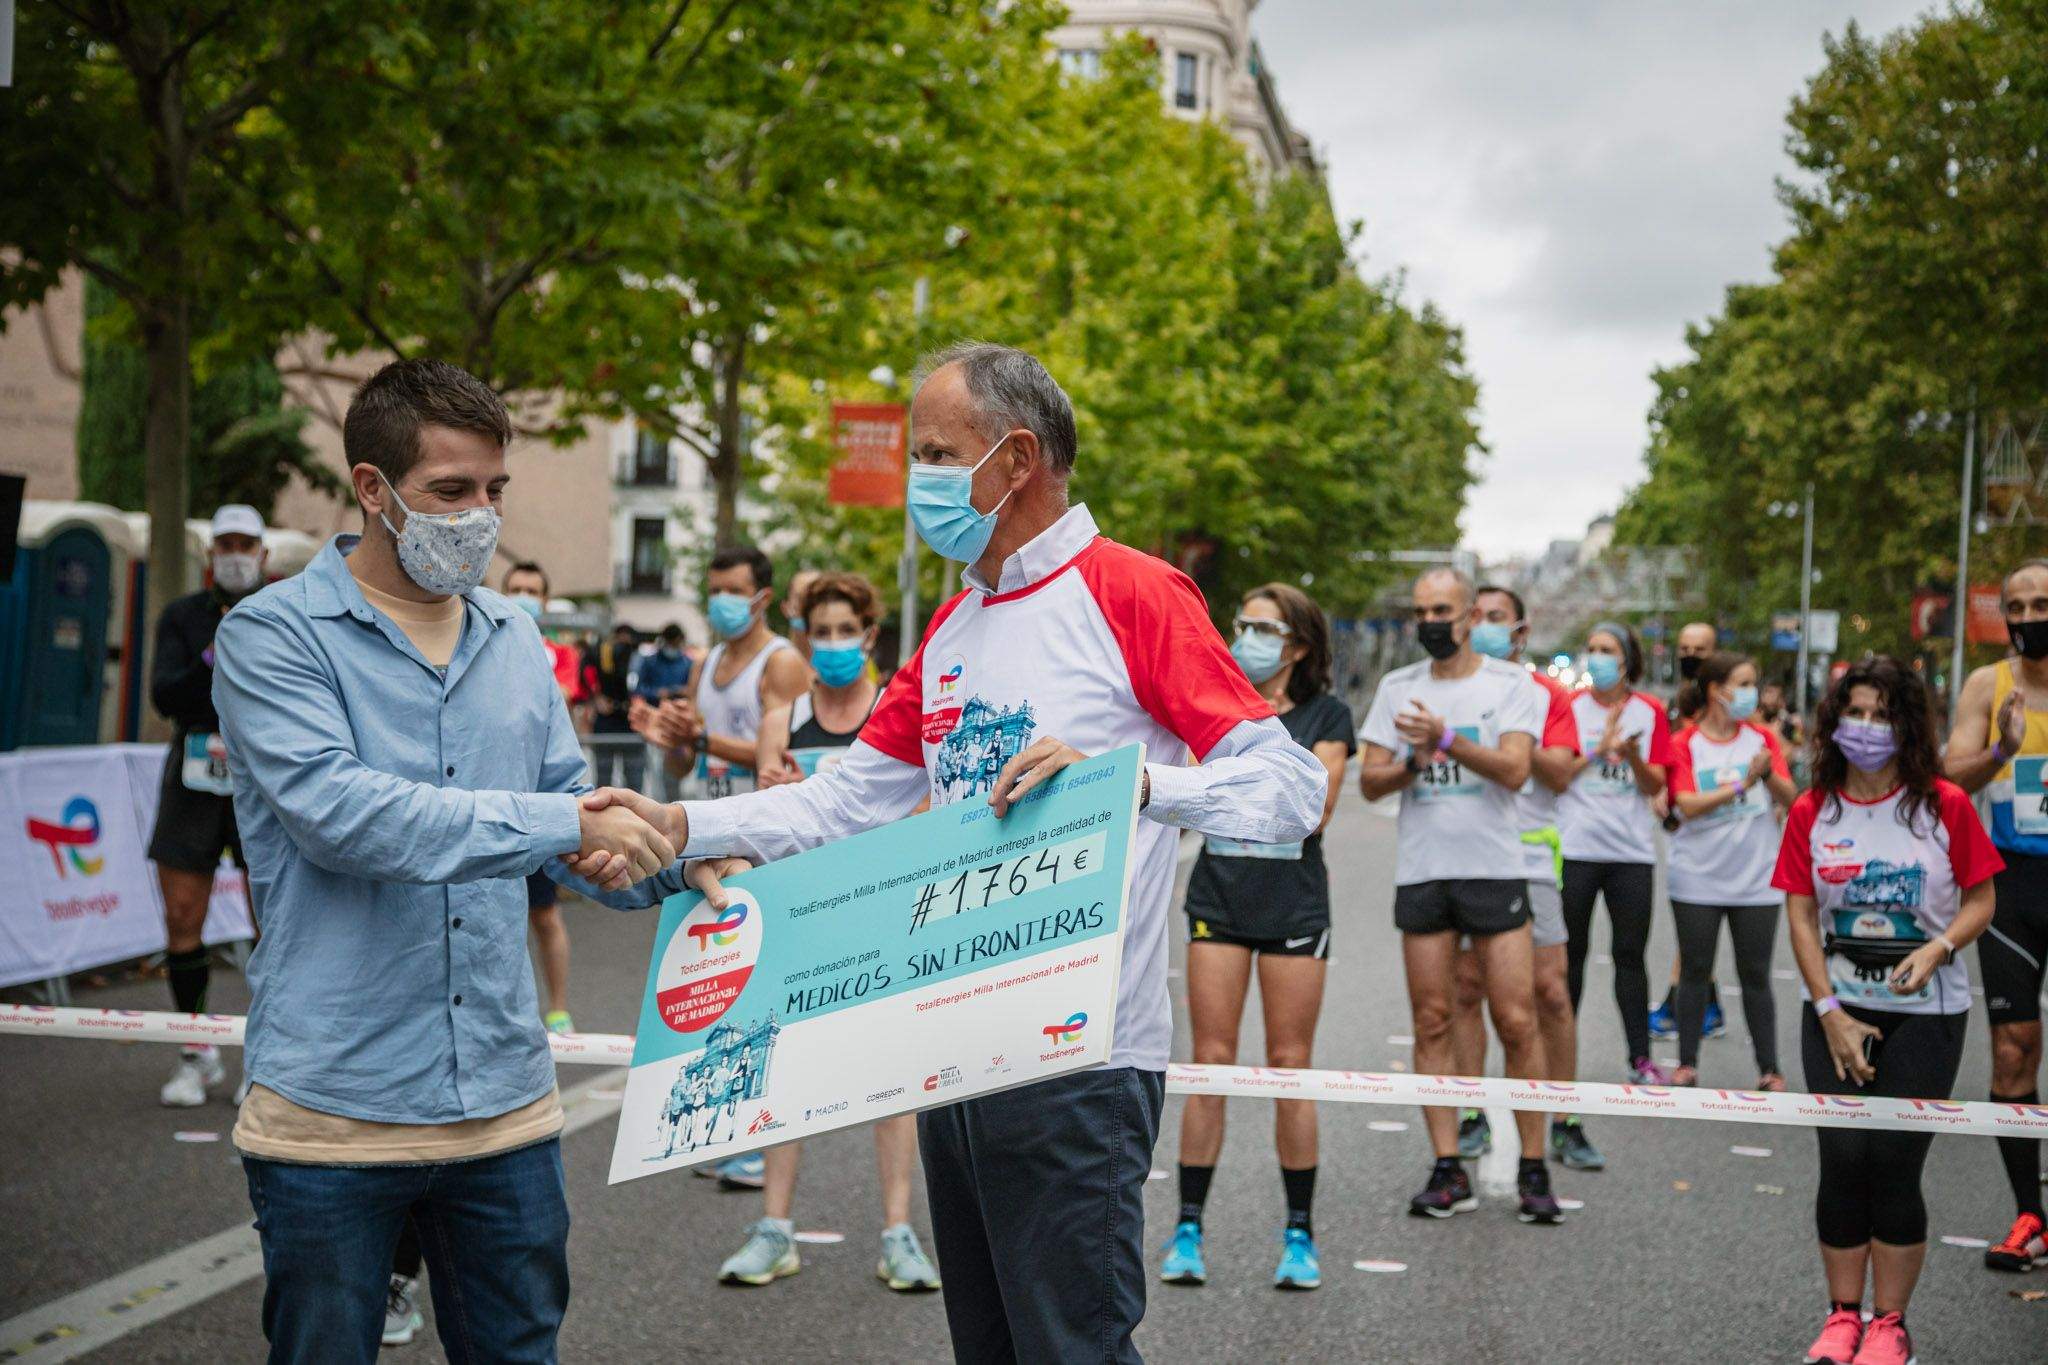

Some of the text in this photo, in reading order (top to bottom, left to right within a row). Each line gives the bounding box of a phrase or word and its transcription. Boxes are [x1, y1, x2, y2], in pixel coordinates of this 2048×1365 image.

[788, 810, 1112, 920] TotalEnergies Milla Internacional de Madrid entrega la cantidad de
[1073, 849, 1089, 870] €
[680, 951, 742, 976] TotalEnergies
[786, 901, 1105, 1014] MEDICOS SIN FRONTERAS
[784, 949, 881, 985] como donación para
[689, 979, 719, 997] MILLA
[915, 953, 1100, 1012] TotalEnergies Milla Internacional de Madrid
[665, 986, 739, 1016] INTERNACIONAL
[673, 1002, 725, 1025] DE MADRID
[1039, 1045, 1086, 1063] TotalEnergies
[1231, 1076, 1302, 1089] TotalEnergies
[1323, 1081, 1394, 1093] TotalEnergies
[1415, 1086, 1487, 1098] TotalEnergies
[1509, 1091, 1581, 1103] TotalEnergies
[814, 1101, 849, 1118] MADRID
[1602, 1096, 1677, 1109] TotalEnergies
[1699, 1101, 1776, 1113] TotalEnergies
[1796, 1107, 1873, 1119] TotalEnergies
[1895, 1112, 1972, 1124] TotalEnergies
